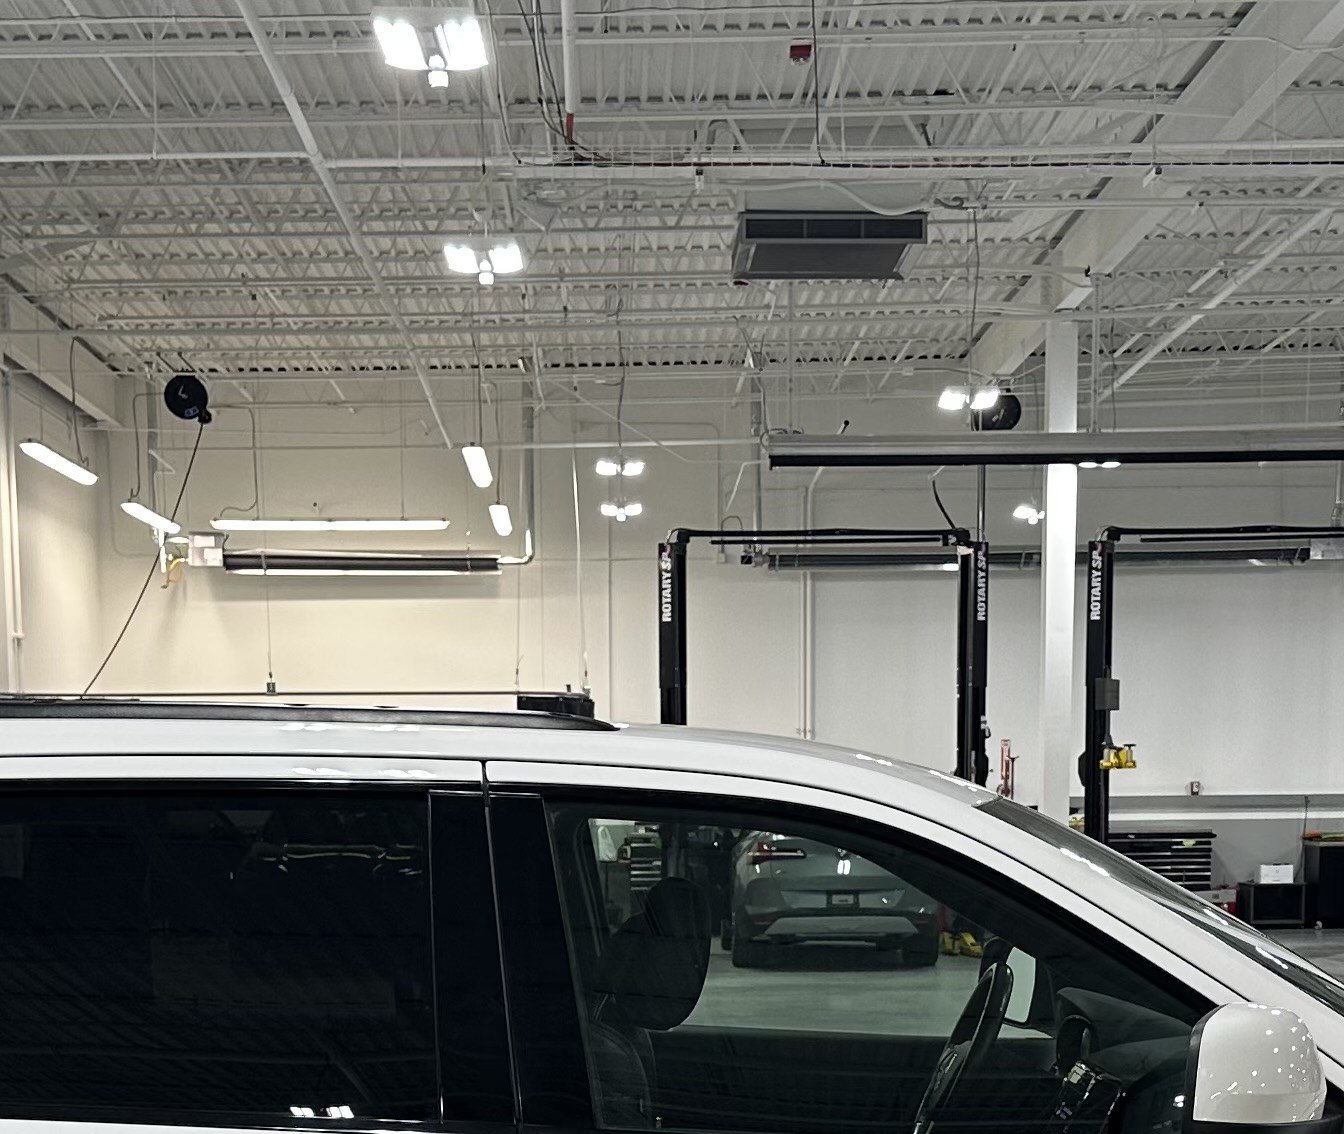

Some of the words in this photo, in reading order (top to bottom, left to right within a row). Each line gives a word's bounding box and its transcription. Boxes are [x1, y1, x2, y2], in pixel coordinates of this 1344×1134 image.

[1091, 550, 1102, 569] SP
[661, 571, 672, 622] ROTARY
[976, 570, 986, 621] ROTARY
[1090, 569, 1102, 621] ROTARY
